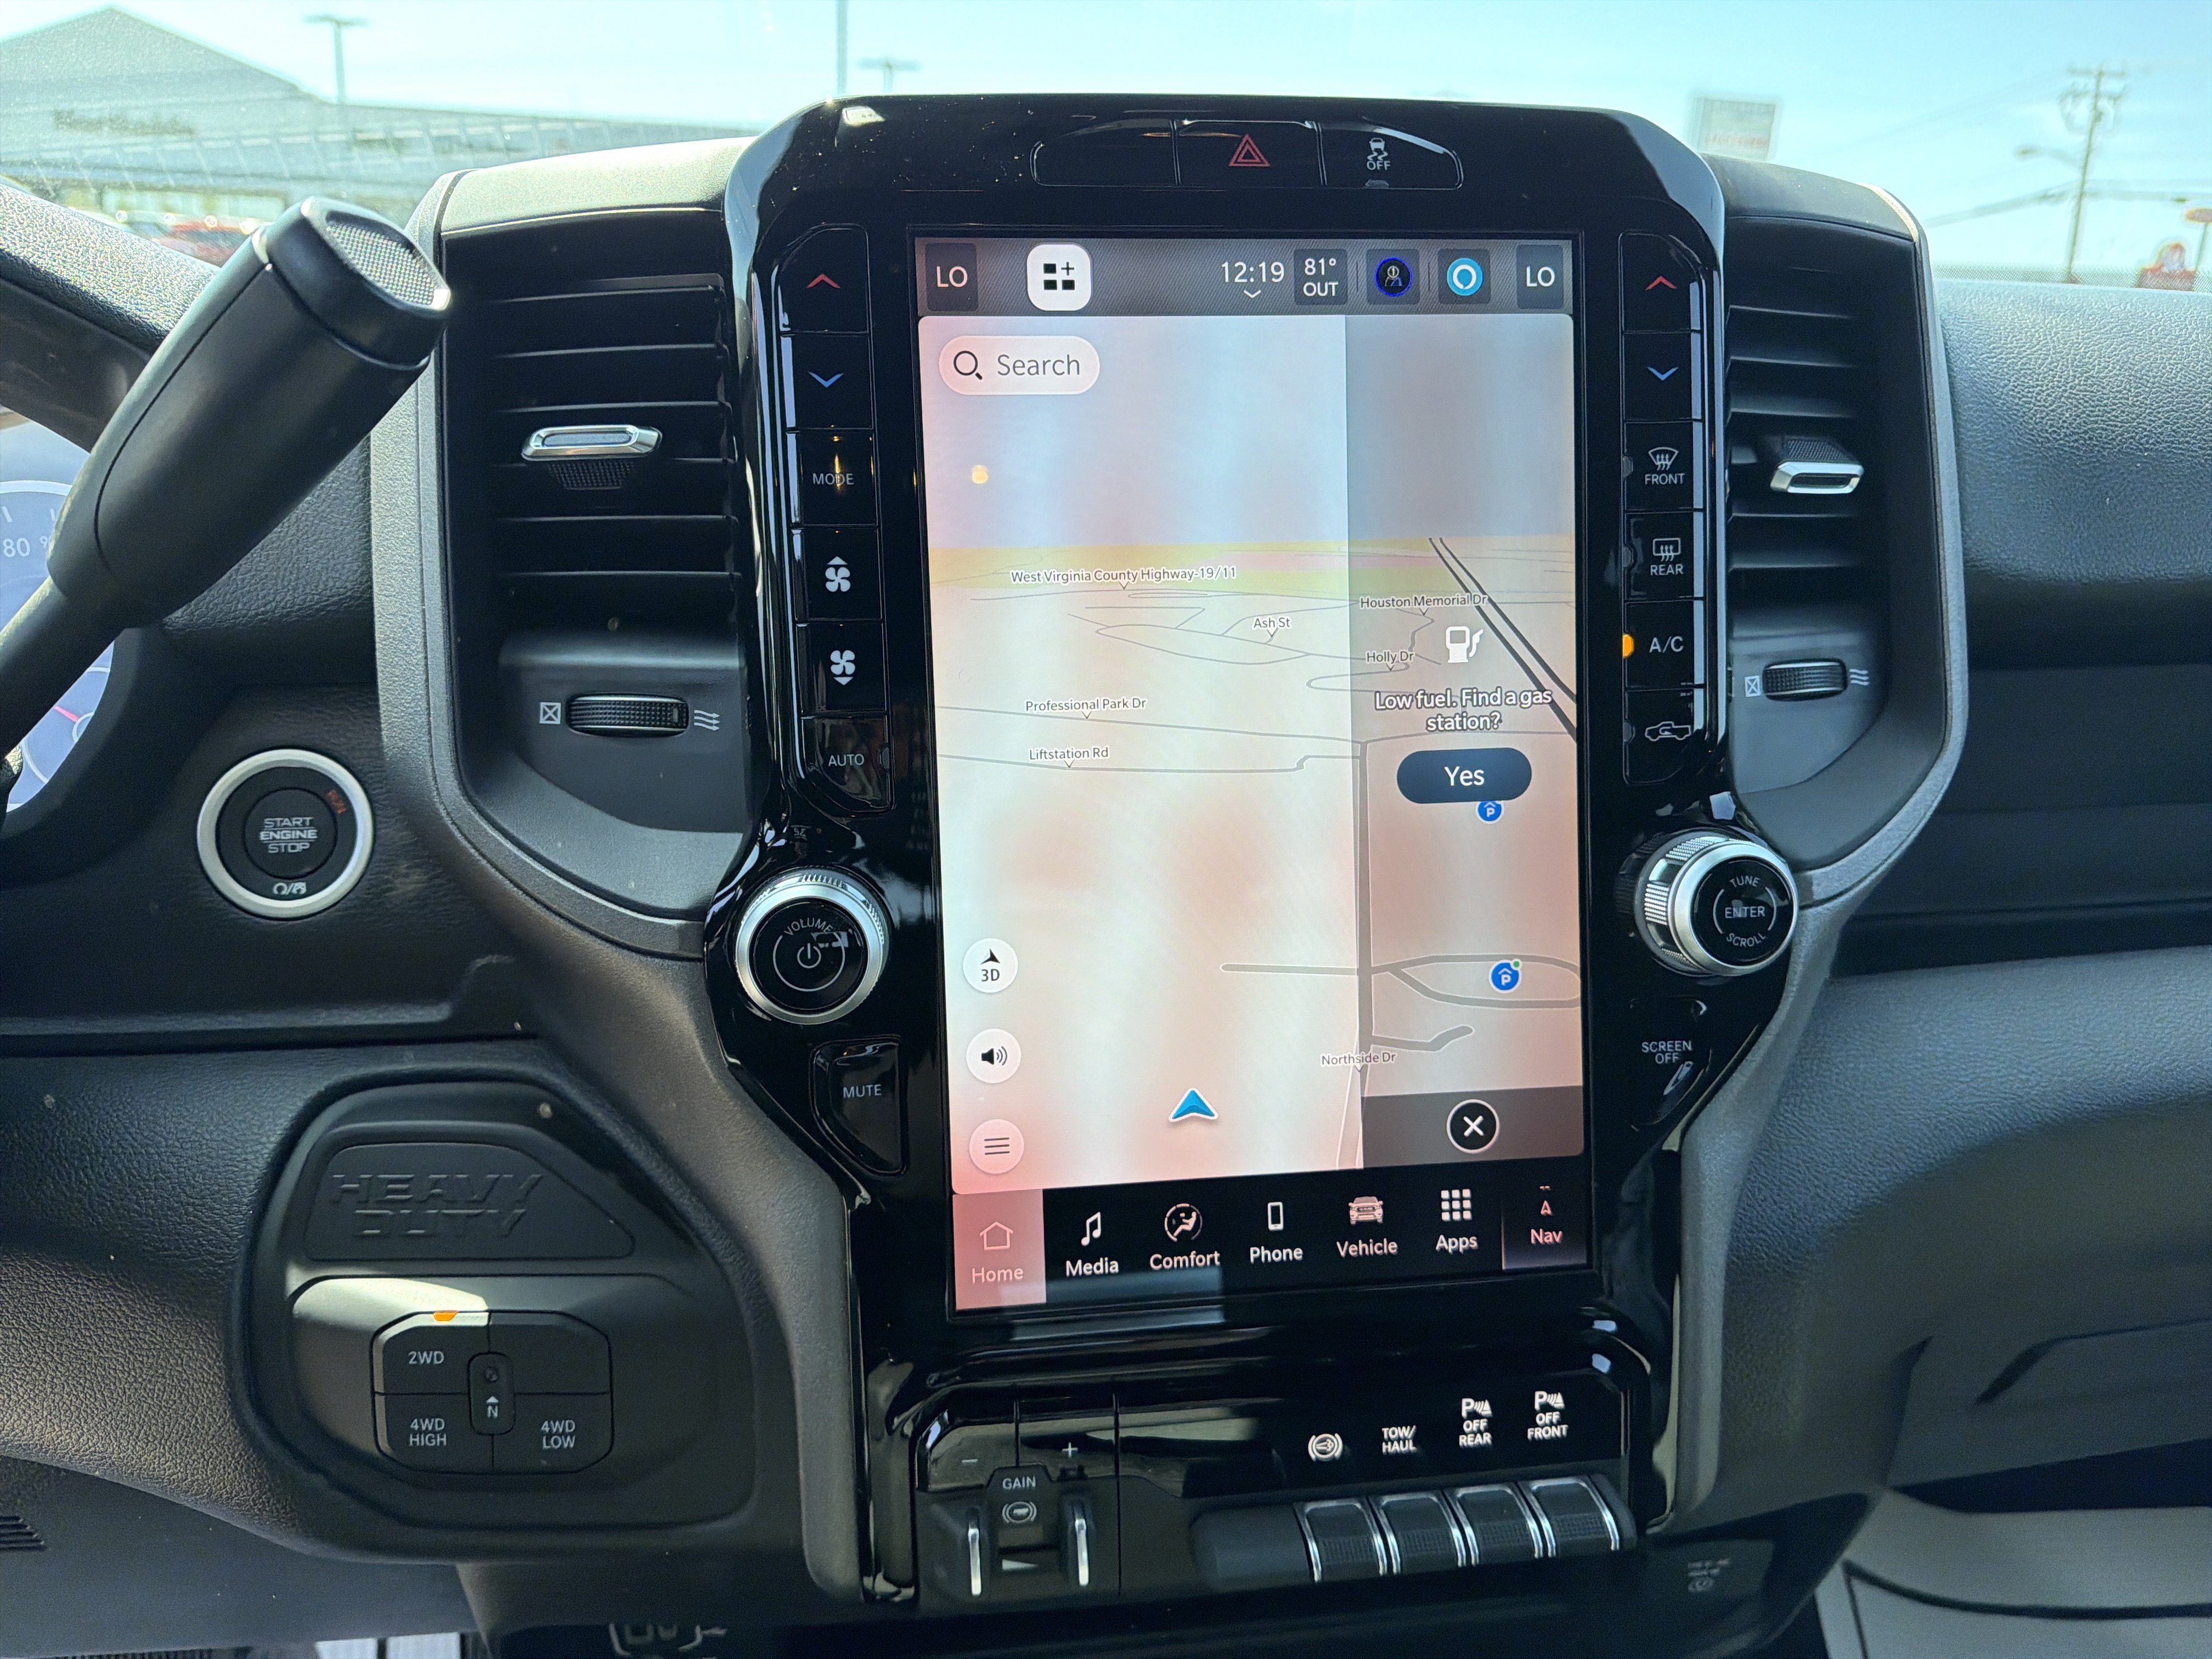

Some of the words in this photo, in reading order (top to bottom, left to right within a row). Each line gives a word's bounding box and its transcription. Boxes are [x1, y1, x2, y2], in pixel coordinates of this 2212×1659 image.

[1367, 161, 1391, 171] OFF
[1221, 261, 1285, 284] 12:19
[1304, 258, 1337, 276] 81°
[936, 266, 968, 288] LO
[1526, 266, 1555, 287] LO
[1303, 282, 1339, 297] OUT
[997, 354, 1080, 376] Search
[812, 472, 855, 486] MODE
[1645, 473, 1685, 485] FRONT
[3, 538, 31, 557] 80
[1011, 571, 1042, 583] West
[1043, 571, 1091, 584] Virginia
[1093, 569, 1138, 583] County
[1141, 567, 1236, 582] Highway-19/11
[1650, 564, 1684, 576] REAR
[1360, 596, 1412, 608] Houston
[1414, 595, 1471, 607] Memorial
[1472, 594, 1488, 605] Dr
[1254, 617, 1275, 629] Ash
[1278, 617, 1291, 628] St
[1649, 636, 1684, 653] A/C
[1366, 652, 1397, 664] Holly
[1400, 651, 1414, 662] Dr
[1025, 699, 1099, 712] Professional
[1102, 698, 1130, 710] Park
[1132, 698, 1147, 709] Dr
[1374, 692, 1413, 709] Low
[1416, 690, 1457, 708] fuel.
[1460, 687, 1502, 706] Find
[1505, 692, 1516, 704] a
[1519, 689, 1553, 708] gas
[1426, 712, 1502, 731] station?
[828, 754, 865, 768] AUTO
[1029, 748, 1090, 761] Liftstation
[1093, 747, 1109, 759] Rd
[1444, 765, 1485, 786] Yes
[263, 817, 314, 828] START
[259, 830, 318, 841] ENGINE
[268, 842, 310, 854] STOP
[1729, 876, 1761, 889] TUNE
[1725, 906, 1765, 919] ENTER
[784, 917, 834, 936] VOLUME
[1726, 933, 1767, 947] SCROLL
[980, 968, 1000, 982] 3D
[1641, 1040, 1692, 1052] SCREEN
[1321, 1052, 1379, 1065] Northside
[1382, 1052, 1397, 1063] Dr
[1655, 1053, 1679, 1064] OFF
[843, 1084, 882, 1098] MUTE
[332, 1174, 543, 1203] HEAVY
[353, 1209, 527, 1237] DUTY
[1531, 1229, 1562, 1244] Nav
[1336, 1238, 1398, 1258] Vehicle
[1435, 1234, 1478, 1255] Apps
[1150, 1251, 1221, 1271] Comfort
[1250, 1245, 1303, 1264] Phone
[1065, 1257, 1119, 1277] Media
[972, 1266, 1024, 1284] Home
[408, 1351, 444, 1365] 2WD
[487, 1405, 498, 1418] N
[1536, 1411, 1561, 1426] OFF
[410, 1418, 445, 1431] 4WD
[541, 1420, 575, 1434] 4WD
[1463, 1419, 1488, 1434] OFF
[1382, 1425, 1417, 1442] TOW/
[1527, 1424, 1569, 1441] FRONT
[409, 1433, 447, 1447] HIGH
[541, 1435, 575, 1449] LOW
[1459, 1432, 1493, 1449] REAR
[1382, 1440, 1417, 1455] HAUL
[1002, 1476, 1036, 1490] GAIN
